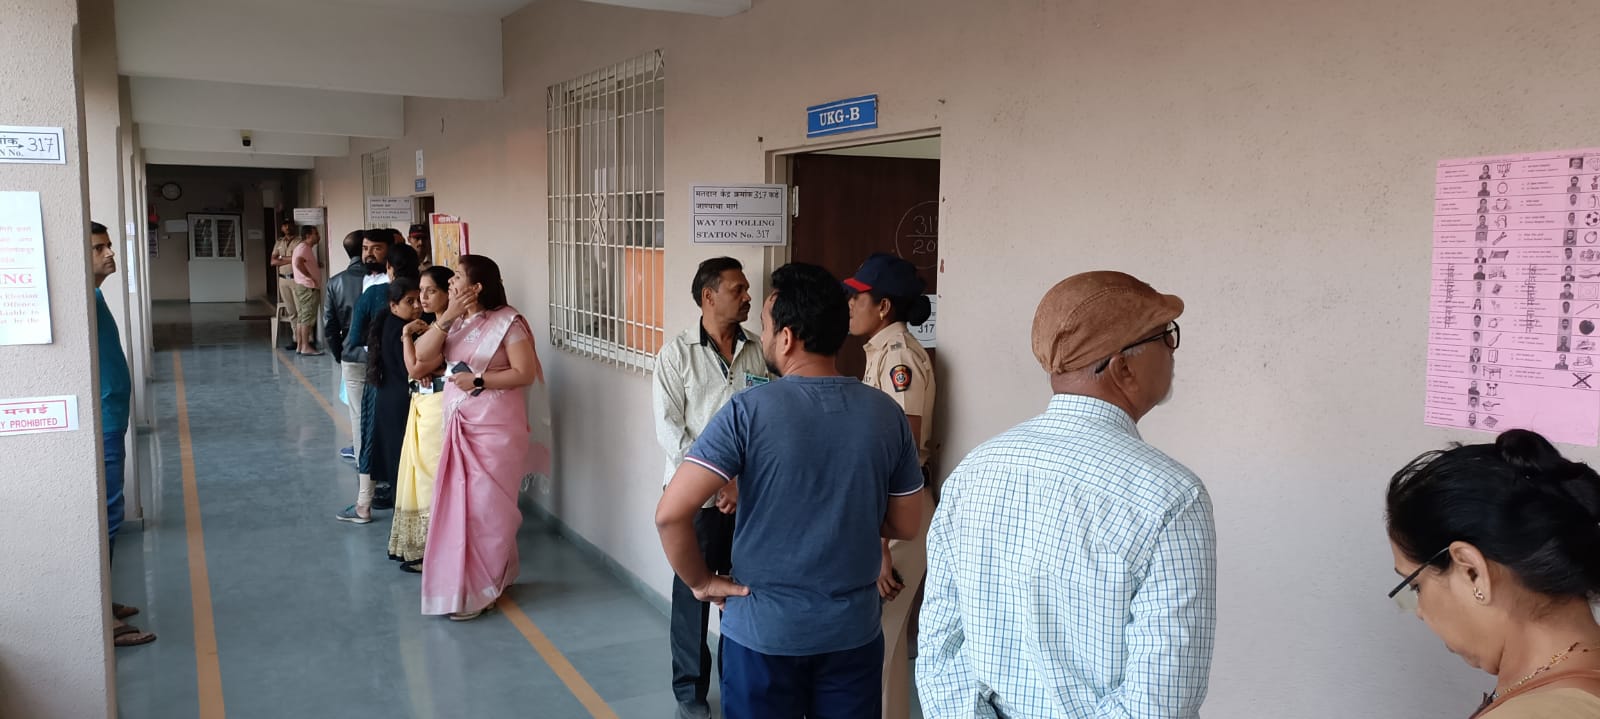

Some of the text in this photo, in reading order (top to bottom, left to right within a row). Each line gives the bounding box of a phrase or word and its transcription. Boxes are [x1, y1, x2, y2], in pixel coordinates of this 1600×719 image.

[819, 106, 861, 127] UKG-B
[27, 137, 54, 153] 317
[695, 190, 717, 198] मतदान
[753, 190, 767, 199] 317
[735, 219, 775, 227] POLLING
[696, 229, 770, 239] STATION No. 317
[917, 323, 935, 333] 317
[3, 404, 48, 415] मनाई
[10, 417, 58, 429] PROHIBITED
